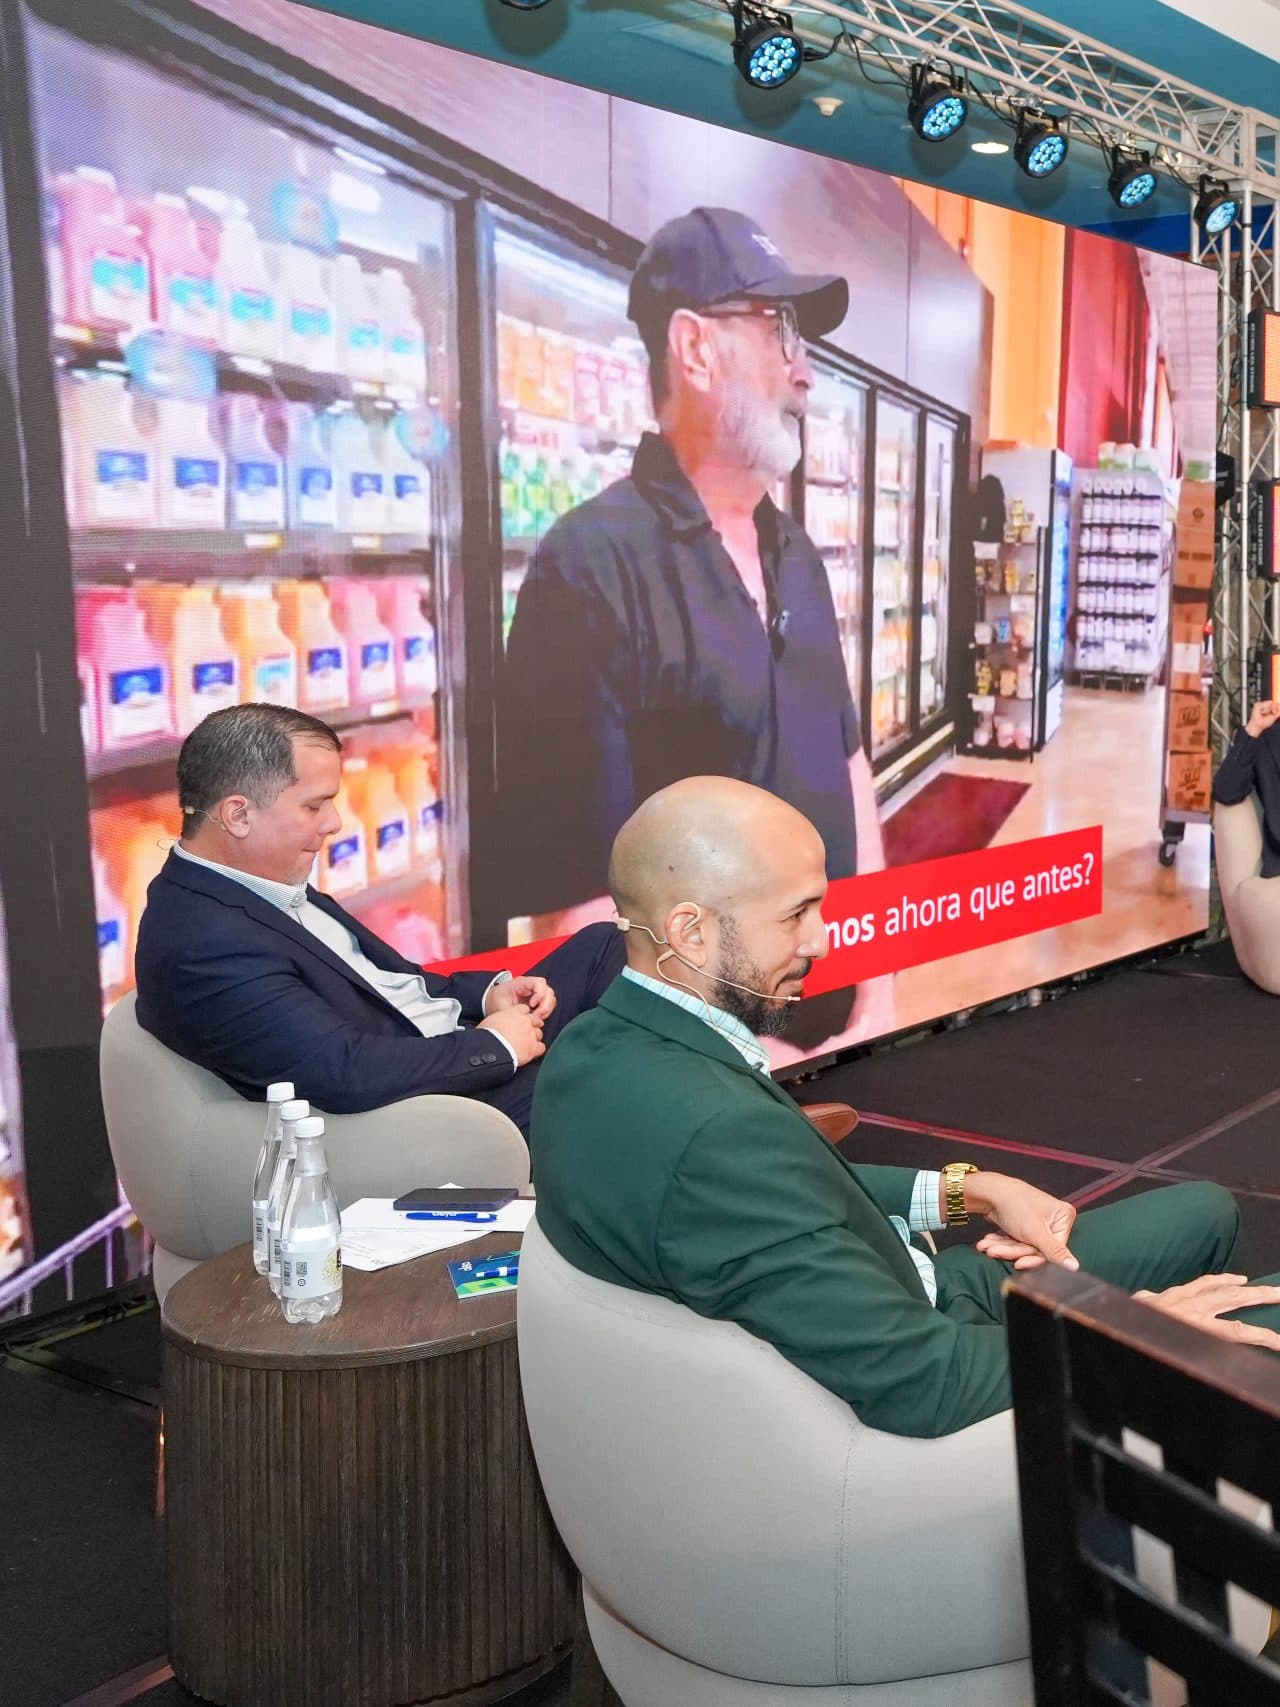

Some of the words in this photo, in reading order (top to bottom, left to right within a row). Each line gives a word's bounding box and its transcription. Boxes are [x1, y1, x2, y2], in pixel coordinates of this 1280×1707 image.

[885, 893, 961, 936] ahora
[970, 880, 1015, 921] que
[1022, 852, 1095, 901] antes?
